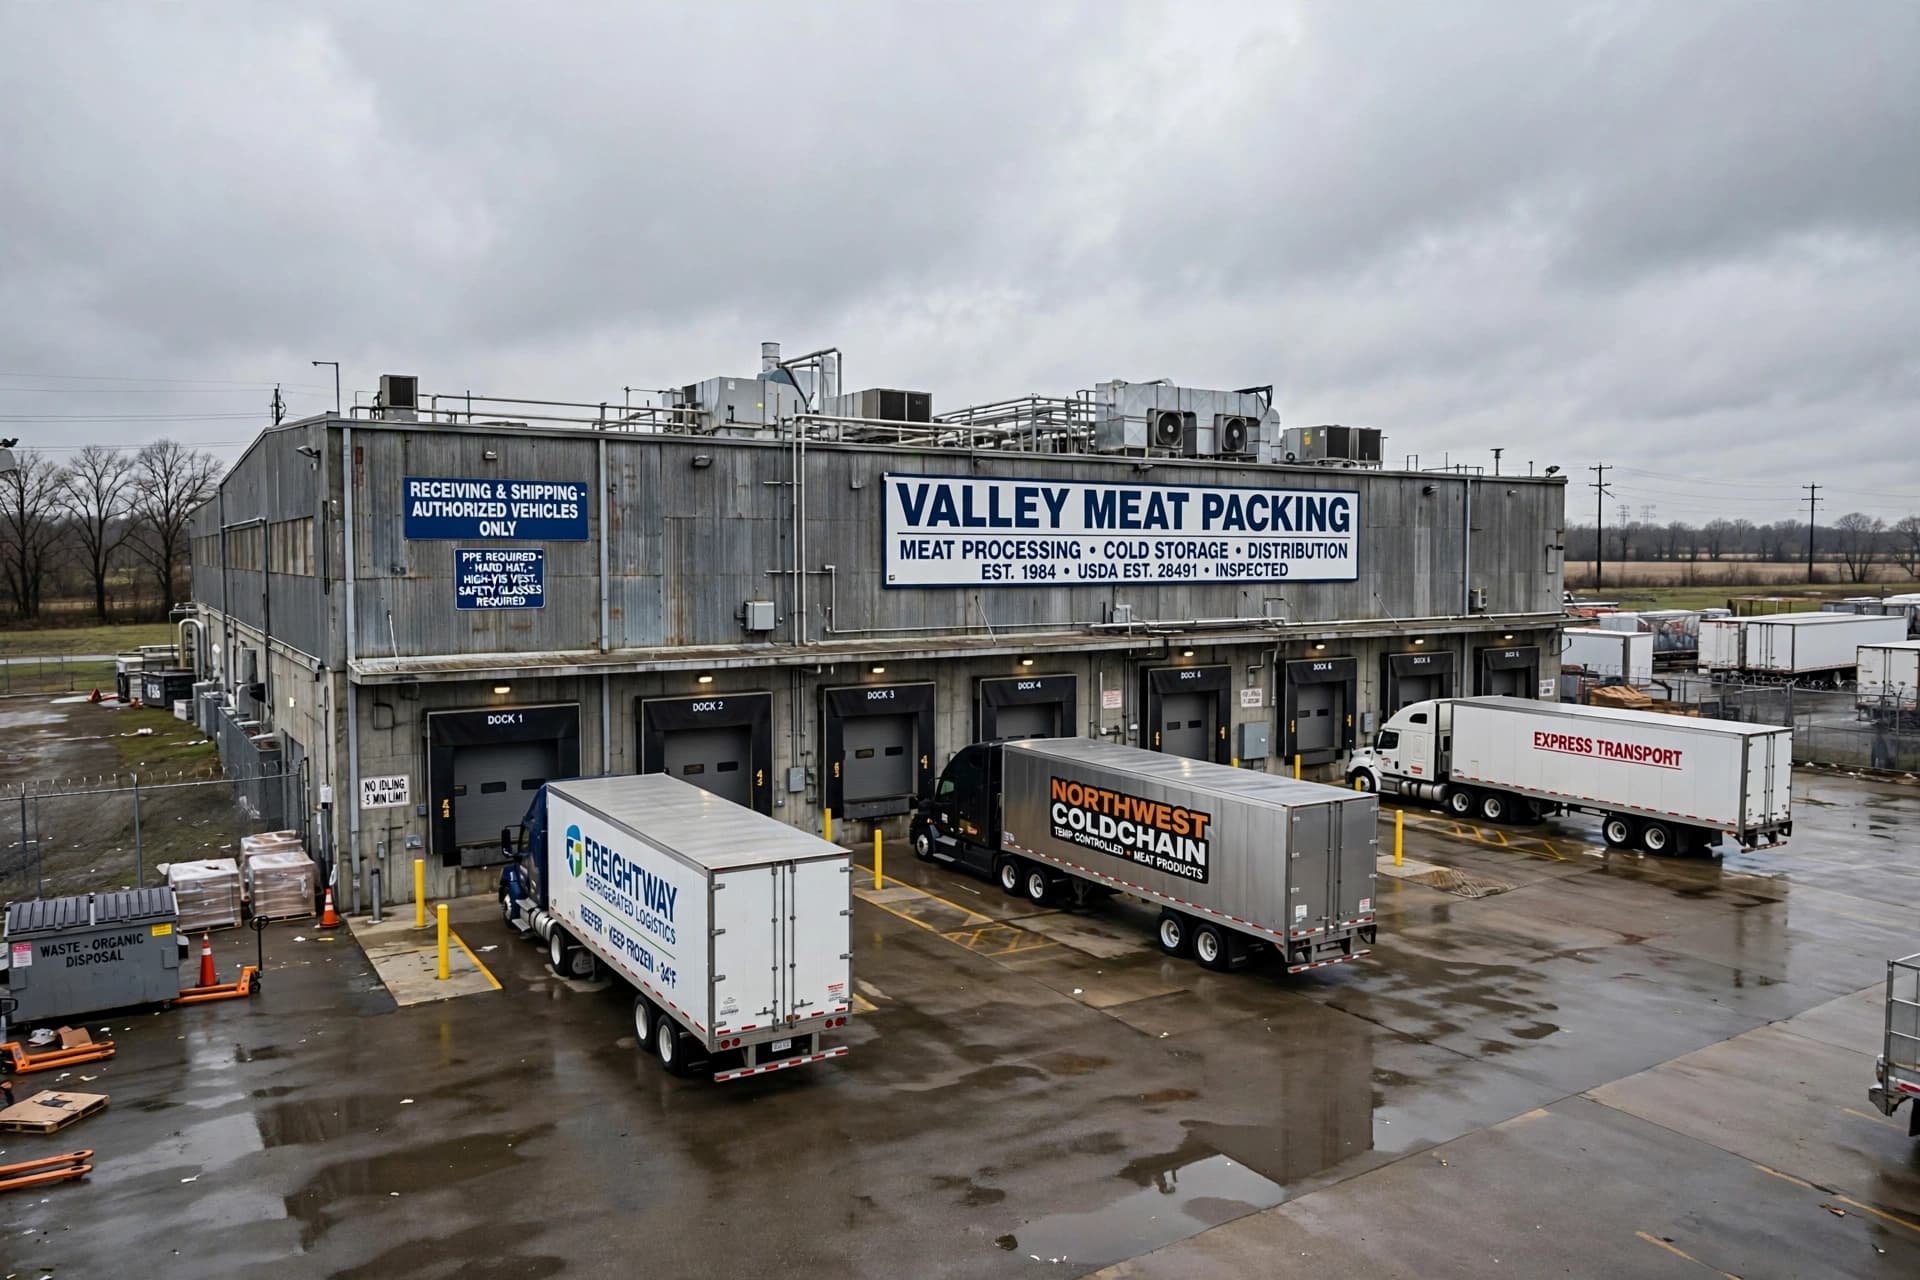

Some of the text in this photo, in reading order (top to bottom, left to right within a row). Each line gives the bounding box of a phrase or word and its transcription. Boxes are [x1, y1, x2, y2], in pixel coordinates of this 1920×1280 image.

[410, 482, 491, 499] RECEIVING
[496, 484, 506, 499] &
[511, 484, 578, 500] SHIPPING
[412, 502, 578, 519] AUTHORIZED VEHICLES
[896, 483, 1350, 533] VALLEY MEAT PACKING
[479, 521, 517, 537] ONLY
[462, 552, 536, 562] PPE REQUIRED
[900, 540, 1348, 560] MEAT PROCESSING COLD STORAGE DISTRIBUTION
[475, 563, 503, 572] HARD
[982, 562, 1289, 580] EST. 1984 USDA EST. 28491 INSPECTED
[464, 574, 508, 584] HIGH-VIS
[476, 597, 526, 607] REQUIRED
[868, 690, 895, 700] DOCK 3
[1018, 682, 1035, 690] DOCK
[693, 701, 724, 712] DOCK 2
[488, 714, 523, 725] DOCK 1
[1534, 731, 1682, 766] EXPRESS TRANSPORT
[365, 778, 405, 792] NO IDLING
[1052, 778, 1208, 839] NORTHWEST
[1052, 802, 1206, 866] COLDCHAIN
[1054, 826, 1203, 880] TEMP CONTROLLED MEAT PRODUCTS
[585, 836, 678, 923] FREIGHTWAY
[586, 872, 676, 945] REFRIGERATED LOGISTICS
[40, 942, 80, 958] WASTE
[92, 933, 144, 950] ORGANIC
[580, 904, 603, 935] REEFER
[609, 924, 625, 950] KEEP
[626, 938, 654, 973] FROZEN
[66, 950, 124, 968] DISPOSAL
